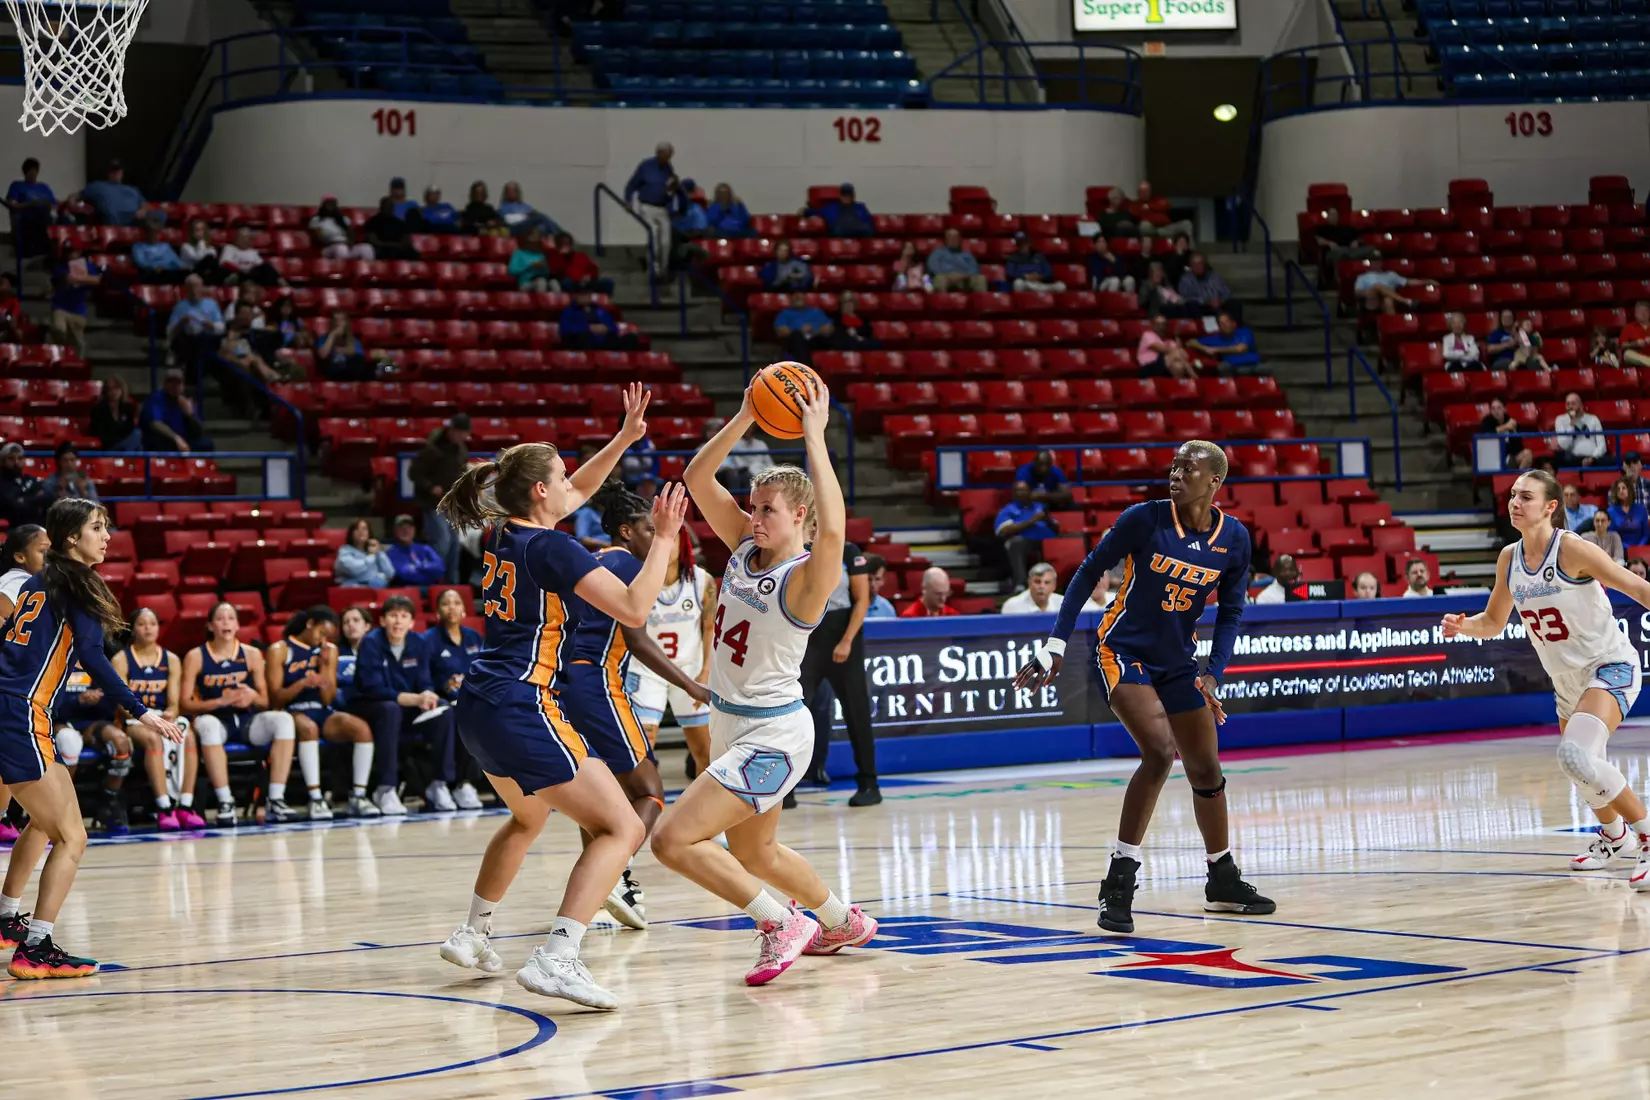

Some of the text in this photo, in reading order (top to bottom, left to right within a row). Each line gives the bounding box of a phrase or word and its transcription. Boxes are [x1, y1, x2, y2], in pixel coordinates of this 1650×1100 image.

[1083, 0, 1225, 23] Super 1 Foods
[371, 108, 416, 137] 101
[832, 115, 882, 142] 102
[1504, 111, 1553, 138] 103
[1150, 552, 1221, 586] UTEP
[482, 550, 516, 621] 23
[1161, 583, 1197, 611] 35
[5, 590, 46, 645] 12
[1520, 607, 1569, 643] 23
[657, 632, 678, 658] 3
[713, 603, 750, 667] 44
[1233, 634, 1312, 655] Mattress
[1315, 629, 1346, 650] and
[1349, 627, 1430, 653] Appliance
[1214, 665, 1495, 699] urniture Partner of Louisiana Tech Athletics
